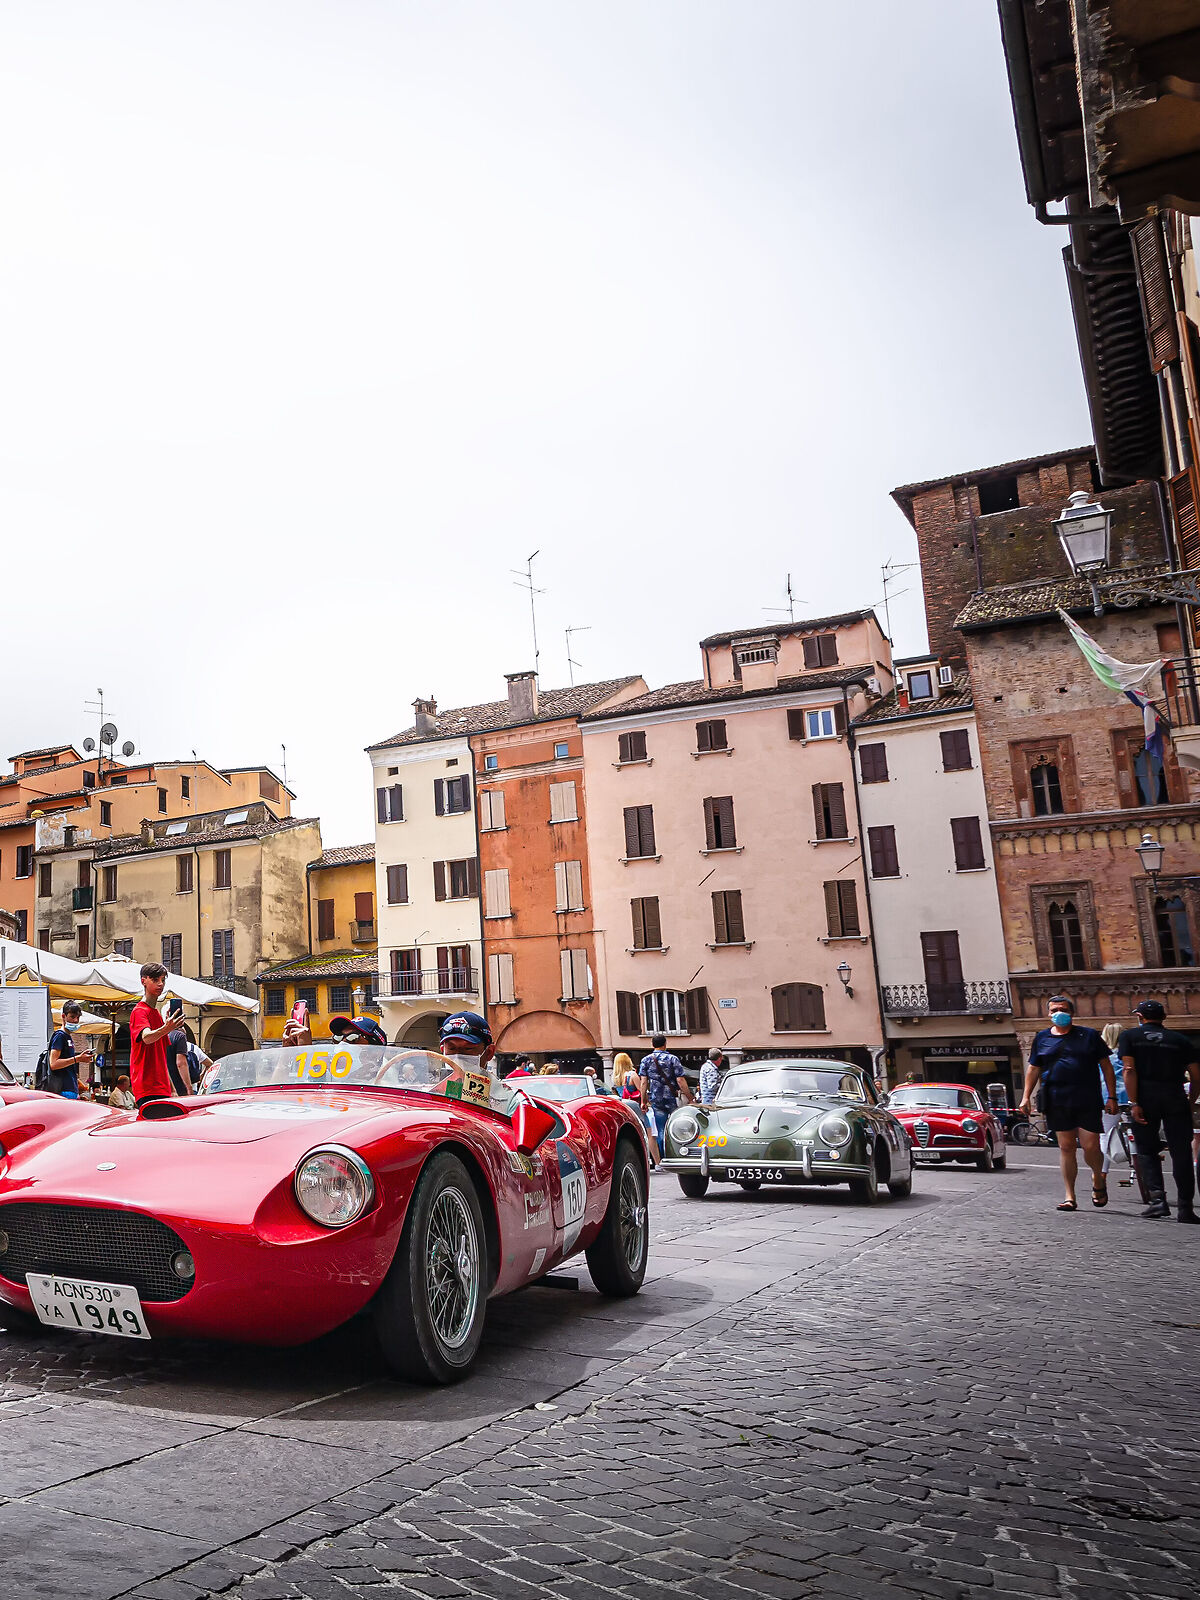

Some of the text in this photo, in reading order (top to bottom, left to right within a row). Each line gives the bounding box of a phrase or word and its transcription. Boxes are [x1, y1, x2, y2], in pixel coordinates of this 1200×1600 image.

[931, 1047, 950, 1055] BAR
[295, 1051, 353, 1078] 150
[469, 1081, 485, 1095] P2
[697, 1134, 728, 1148] 250
[728, 1168, 783, 1180] DZ-53-66
[567, 1178, 583, 1218] 150
[54, 1281, 113, 1303] ACN530
[69, 1301, 142, 1335] 1949
